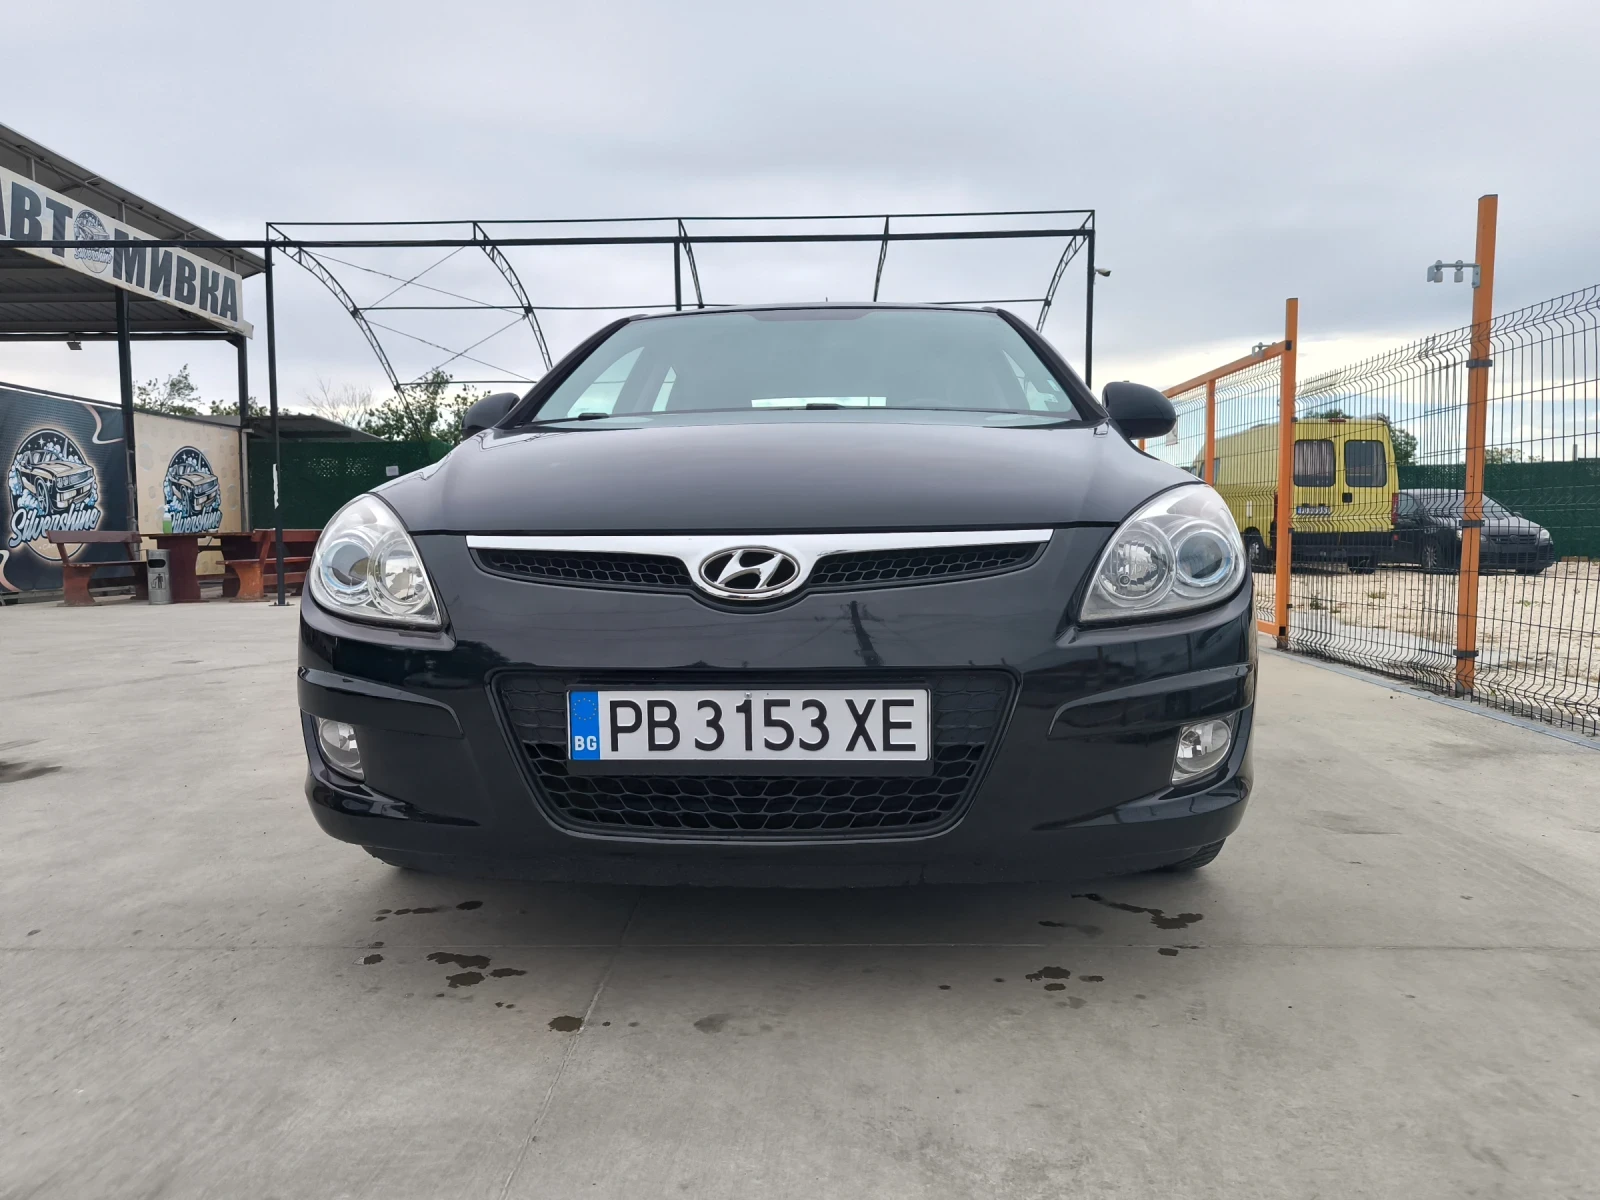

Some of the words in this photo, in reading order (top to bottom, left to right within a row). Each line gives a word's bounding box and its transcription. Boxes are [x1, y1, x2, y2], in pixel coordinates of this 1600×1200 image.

[9, 503, 101, 547] Silvershine
[574, 736, 598, 751] BG
[609, 700, 681, 752] PB
[694, 698, 831, 751] 3153
[845, 699, 917, 751] XE
